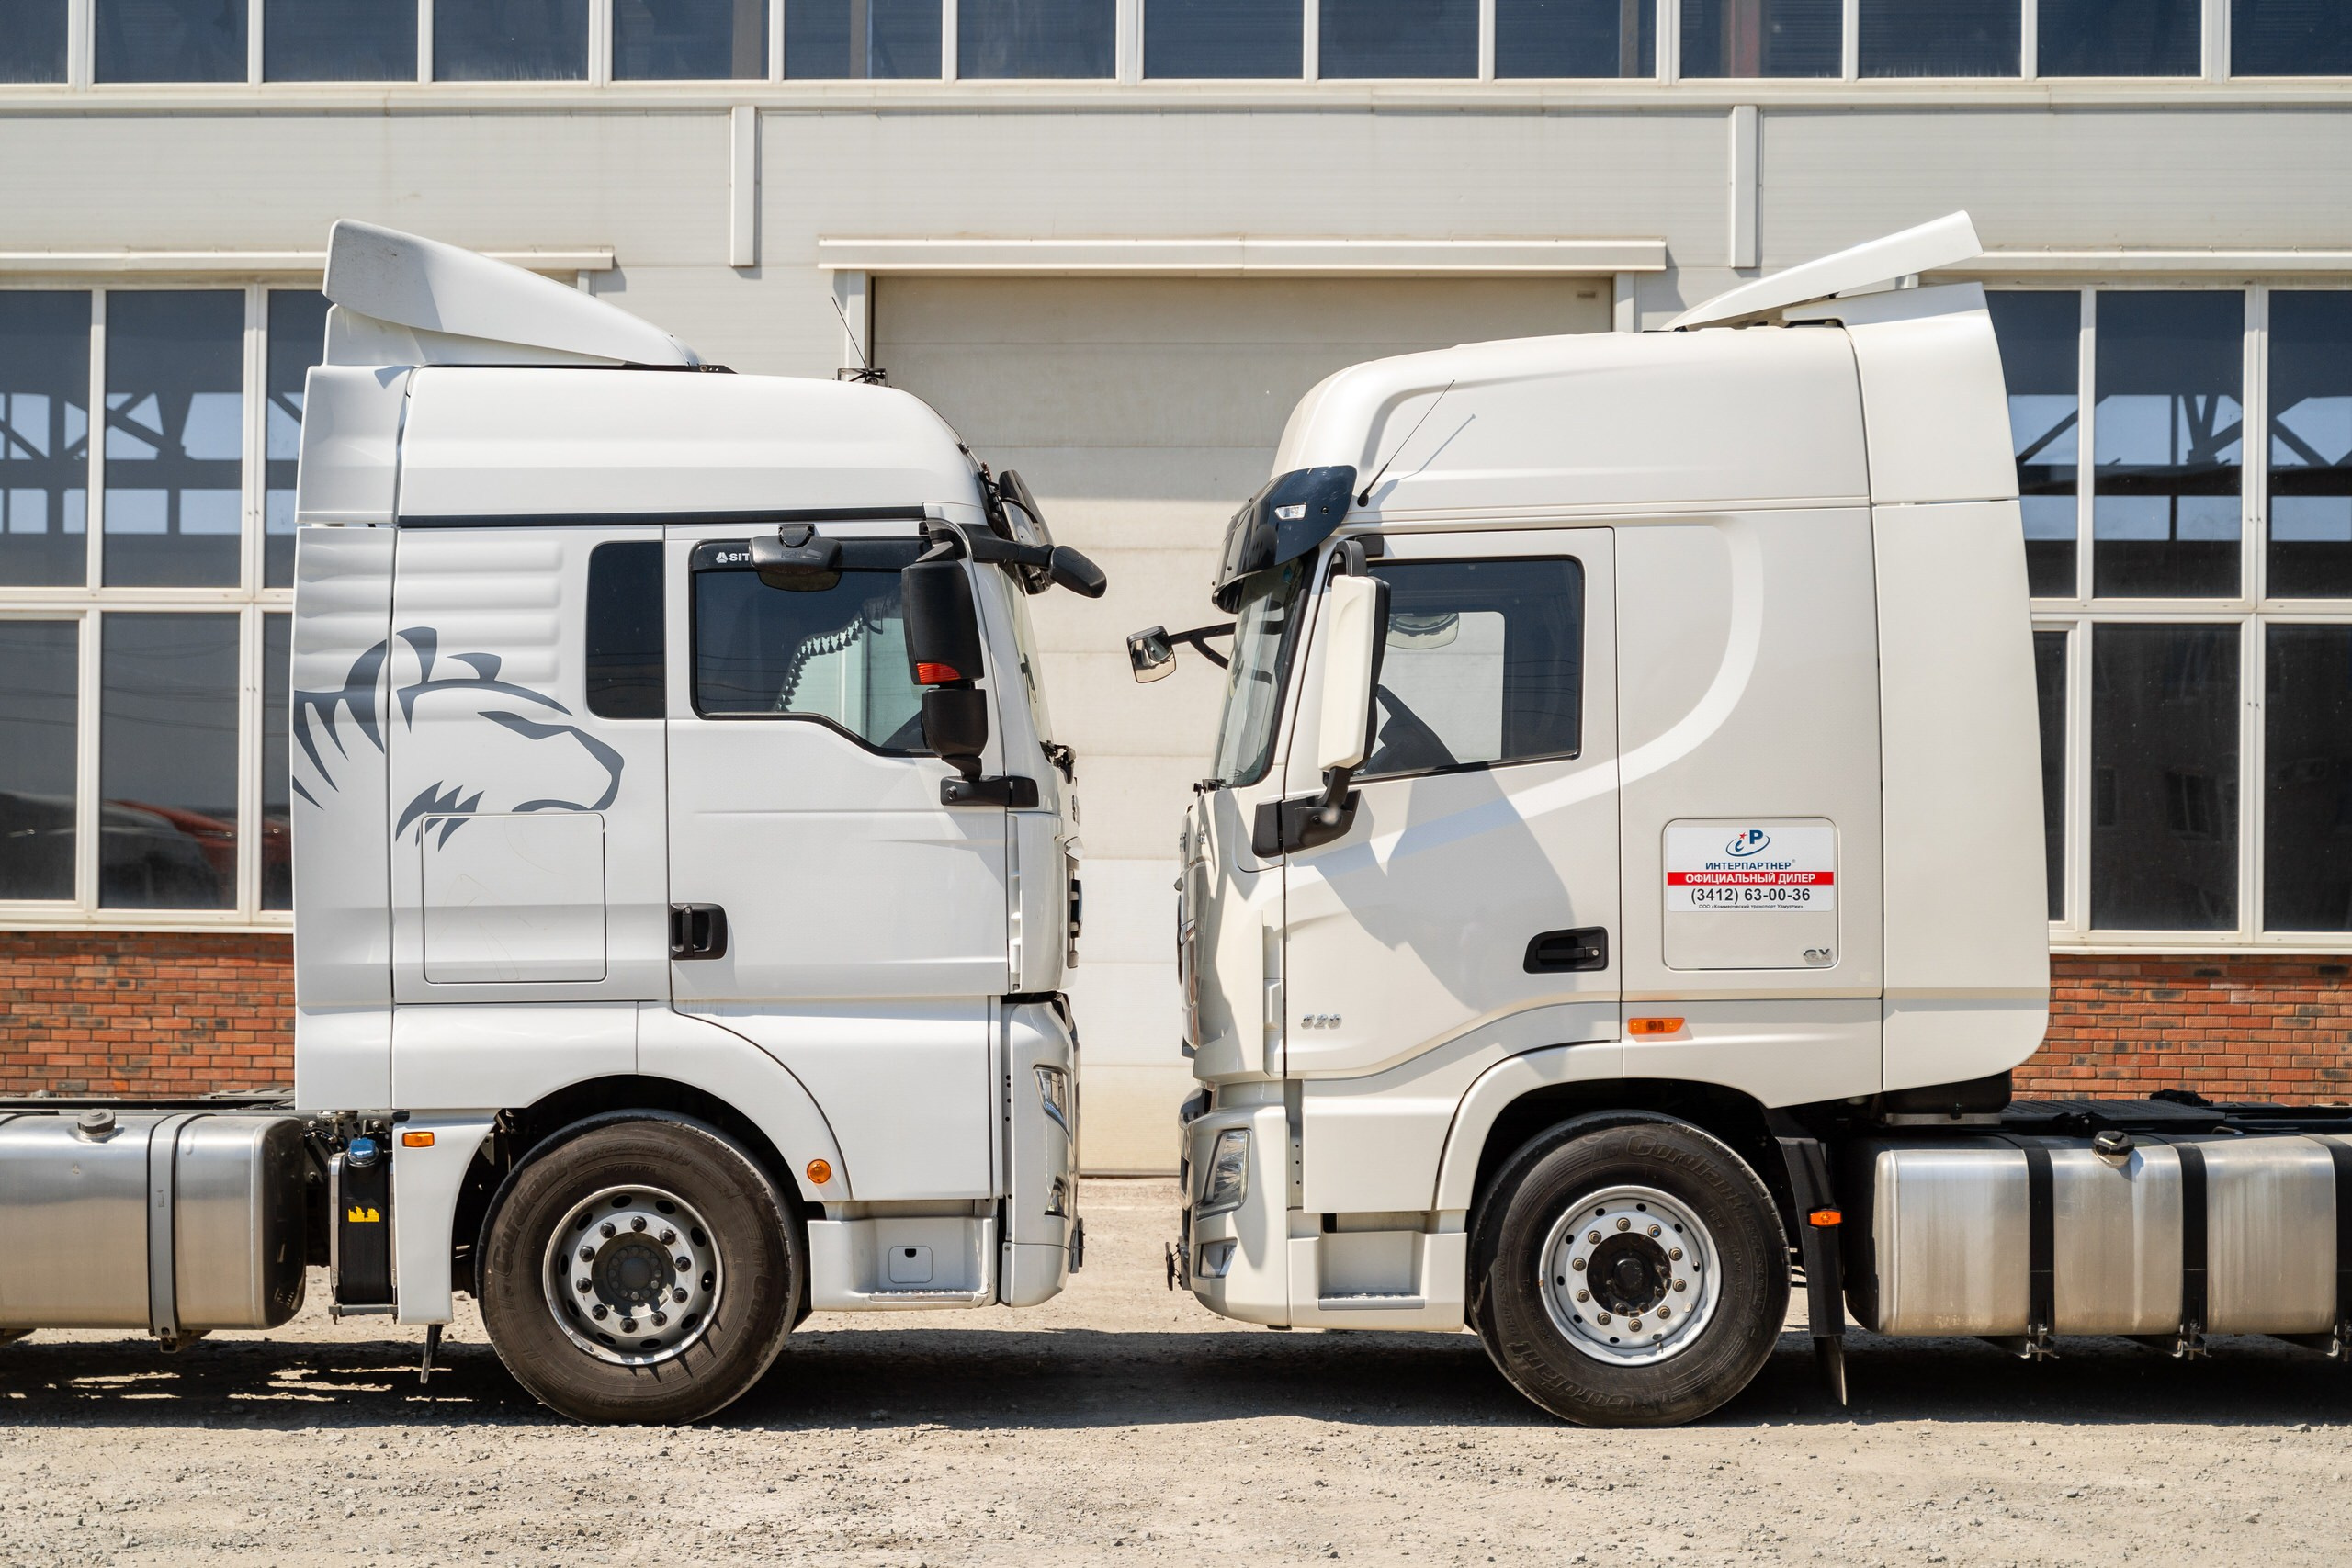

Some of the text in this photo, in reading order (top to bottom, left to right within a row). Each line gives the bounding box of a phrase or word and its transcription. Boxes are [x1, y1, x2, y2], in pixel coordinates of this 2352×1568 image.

[729, 553, 750, 562] SIT
[1705, 862, 1792, 870] ИНТЕРПАРТНЕР
[1685, 872, 1815, 885] ОФИЦИАЛЬНЫЙ ДИЛЕР
[1690, 888, 1811, 904] (3412) 63-00-36
[1300, 1013, 1342, 1030] 520
[1625, 1134, 1748, 1211] Cordiant
[492, 1152, 571, 1276] Cordiant
